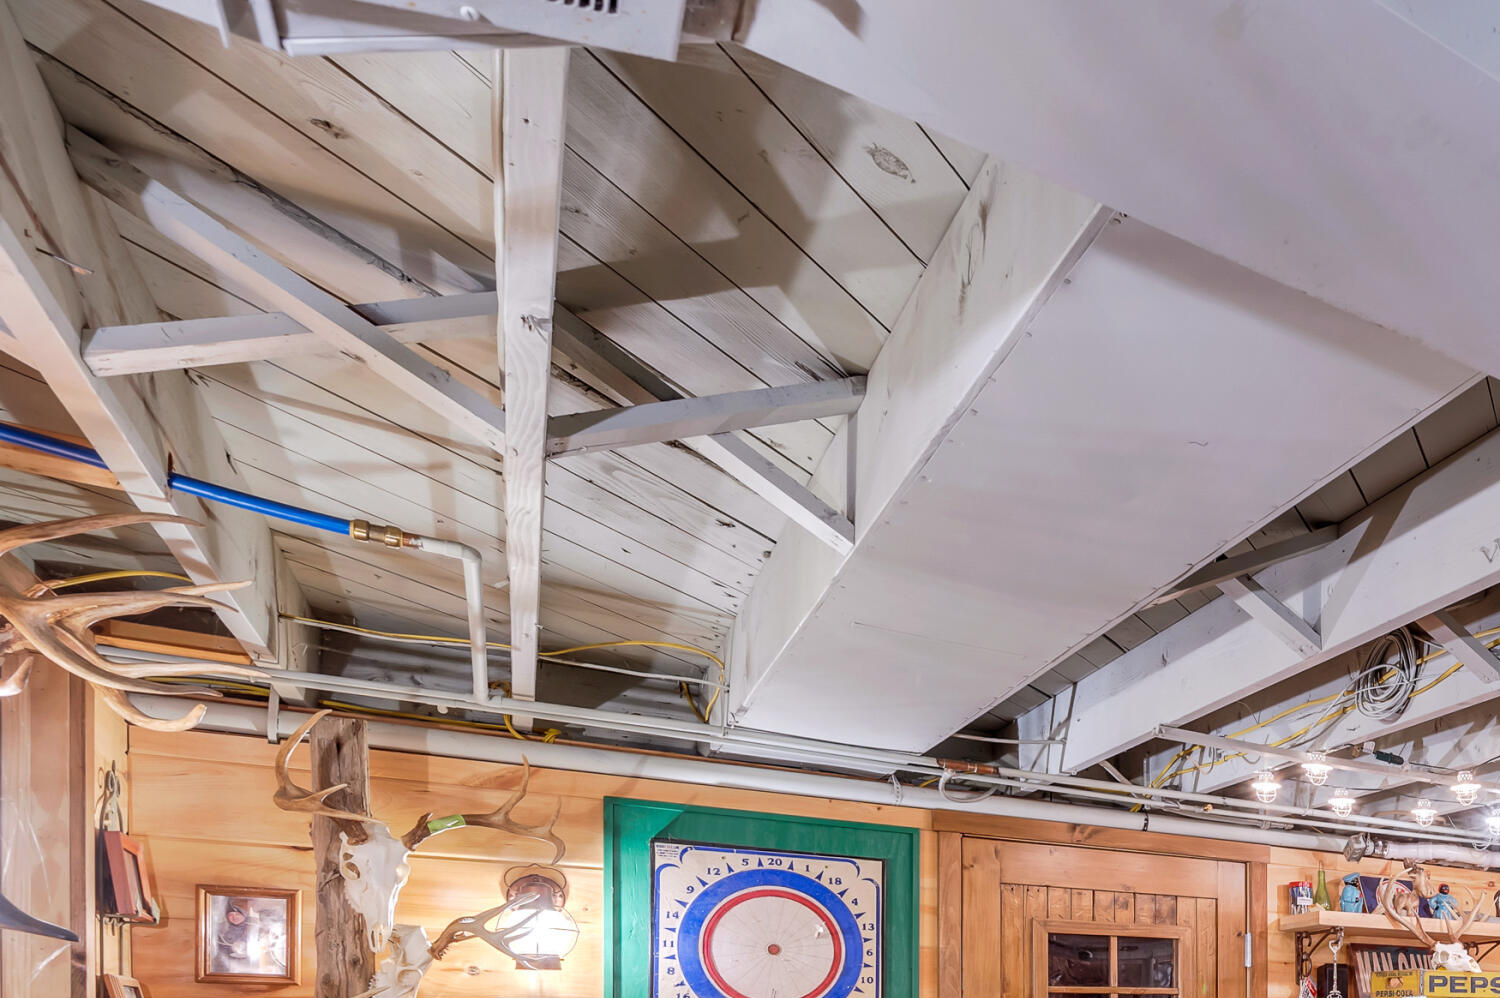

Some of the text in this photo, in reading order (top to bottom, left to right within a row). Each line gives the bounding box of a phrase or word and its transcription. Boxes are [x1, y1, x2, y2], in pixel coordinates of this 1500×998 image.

[741, 858, 749, 866] 5
[767, 857, 783, 866] 20
[707, 867, 721, 876] 12
[805, 864, 810, 872] 1
[828, 877, 842, 885] 18
[686, 885, 695, 894] 9
[851, 897, 859, 906] 4
[666, 911, 679, 919] 14
[862, 923, 875, 931] 13
[663, 939, 674, 948] 11
[666, 967, 675, 975] 8
[861, 976, 874, 984] 10
